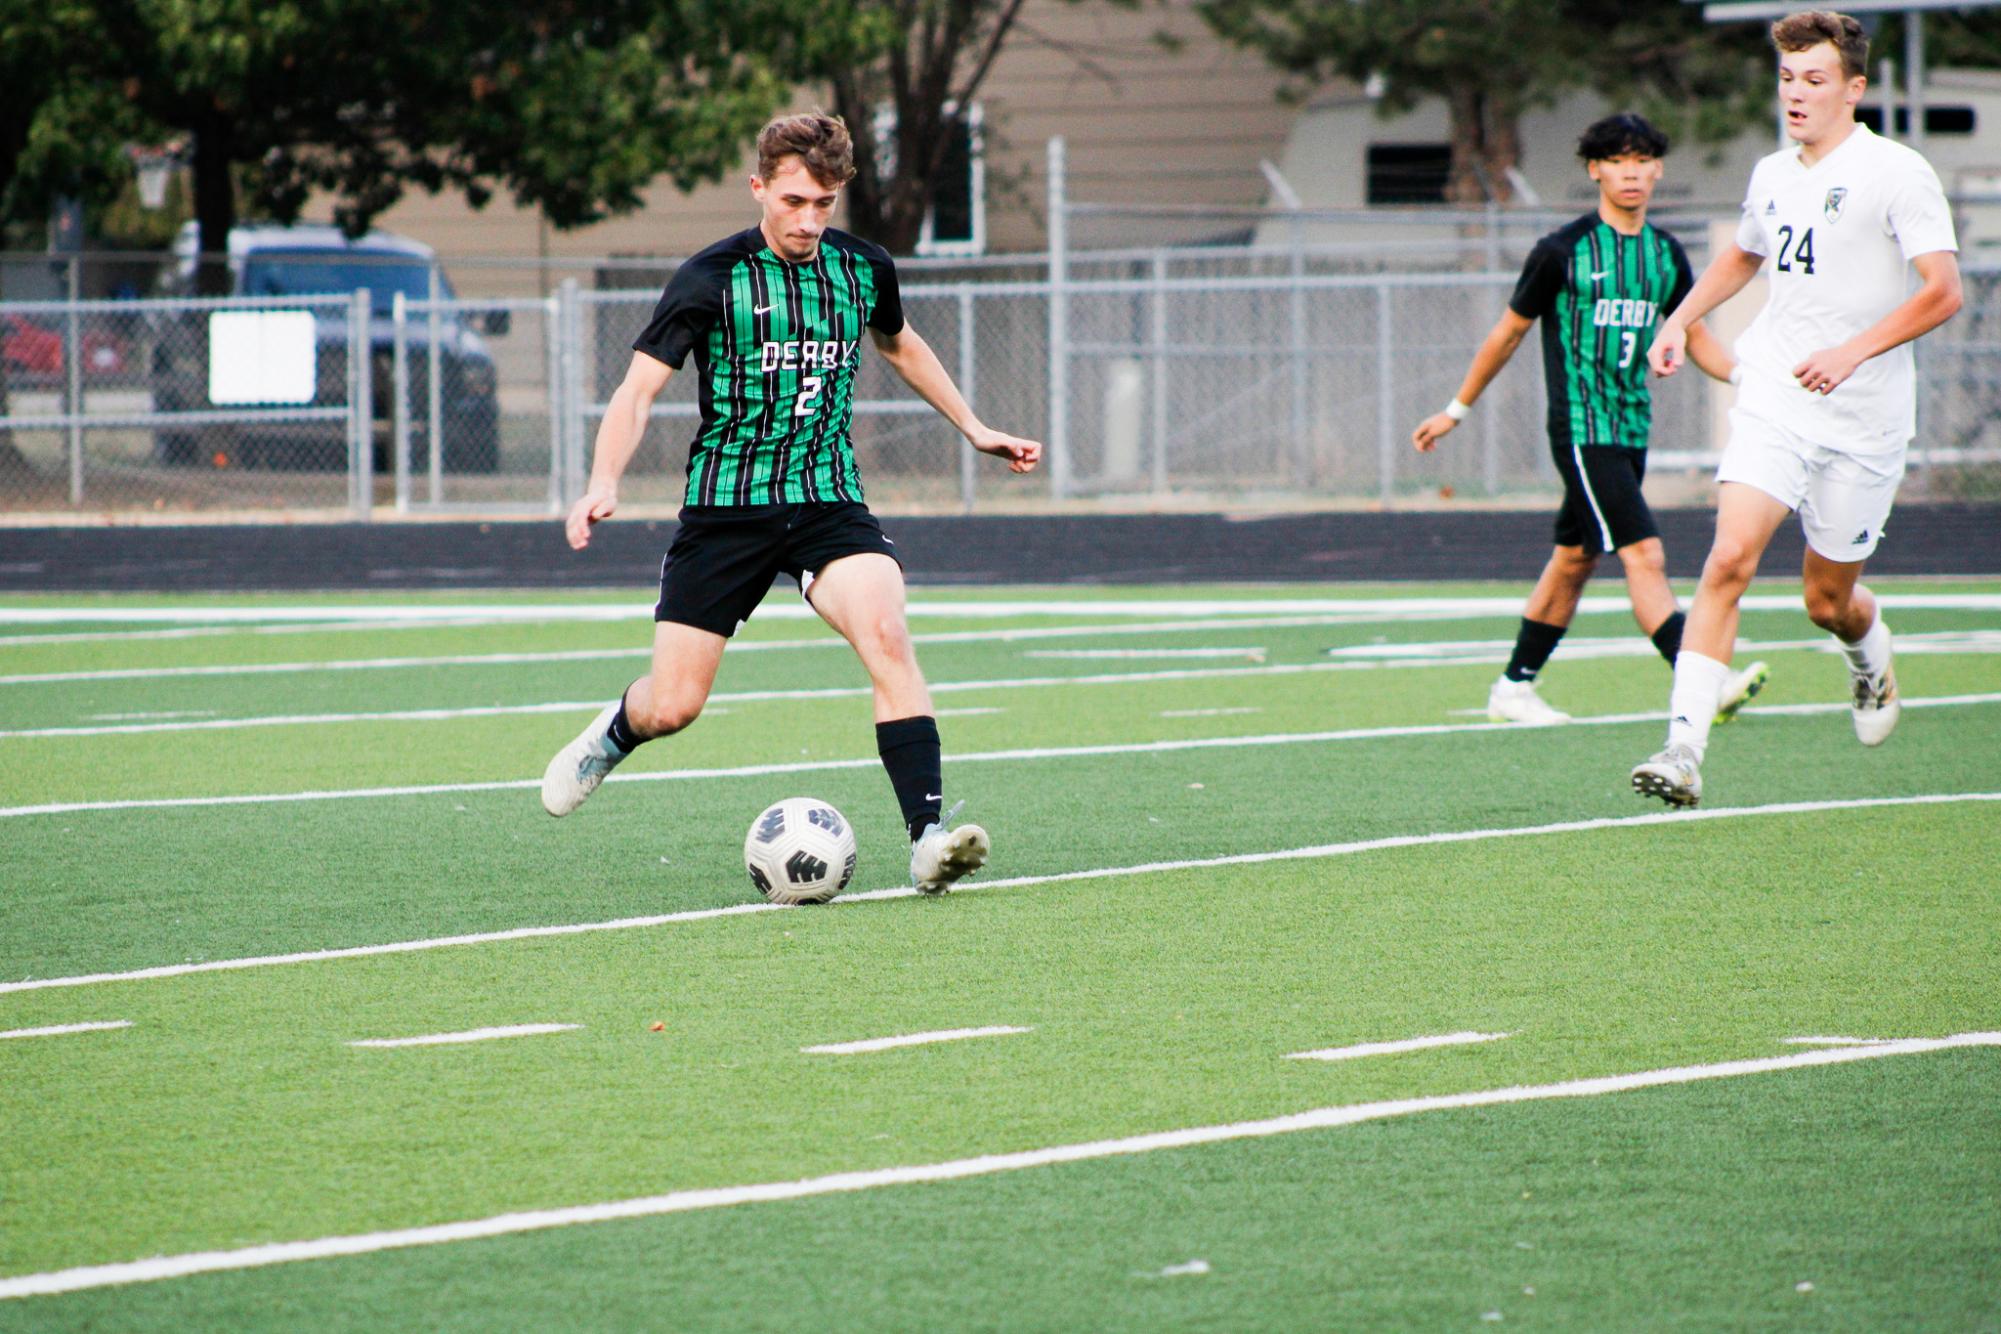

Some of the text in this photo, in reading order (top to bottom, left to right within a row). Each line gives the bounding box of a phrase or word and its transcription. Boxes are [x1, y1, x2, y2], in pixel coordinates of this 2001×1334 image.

[1777, 225, 1815, 275] 24
[1593, 298, 1659, 328] DERBY
[761, 340, 857, 372] DERBY
[1618, 331, 1637, 369] 3
[795, 376, 822, 417] 2
